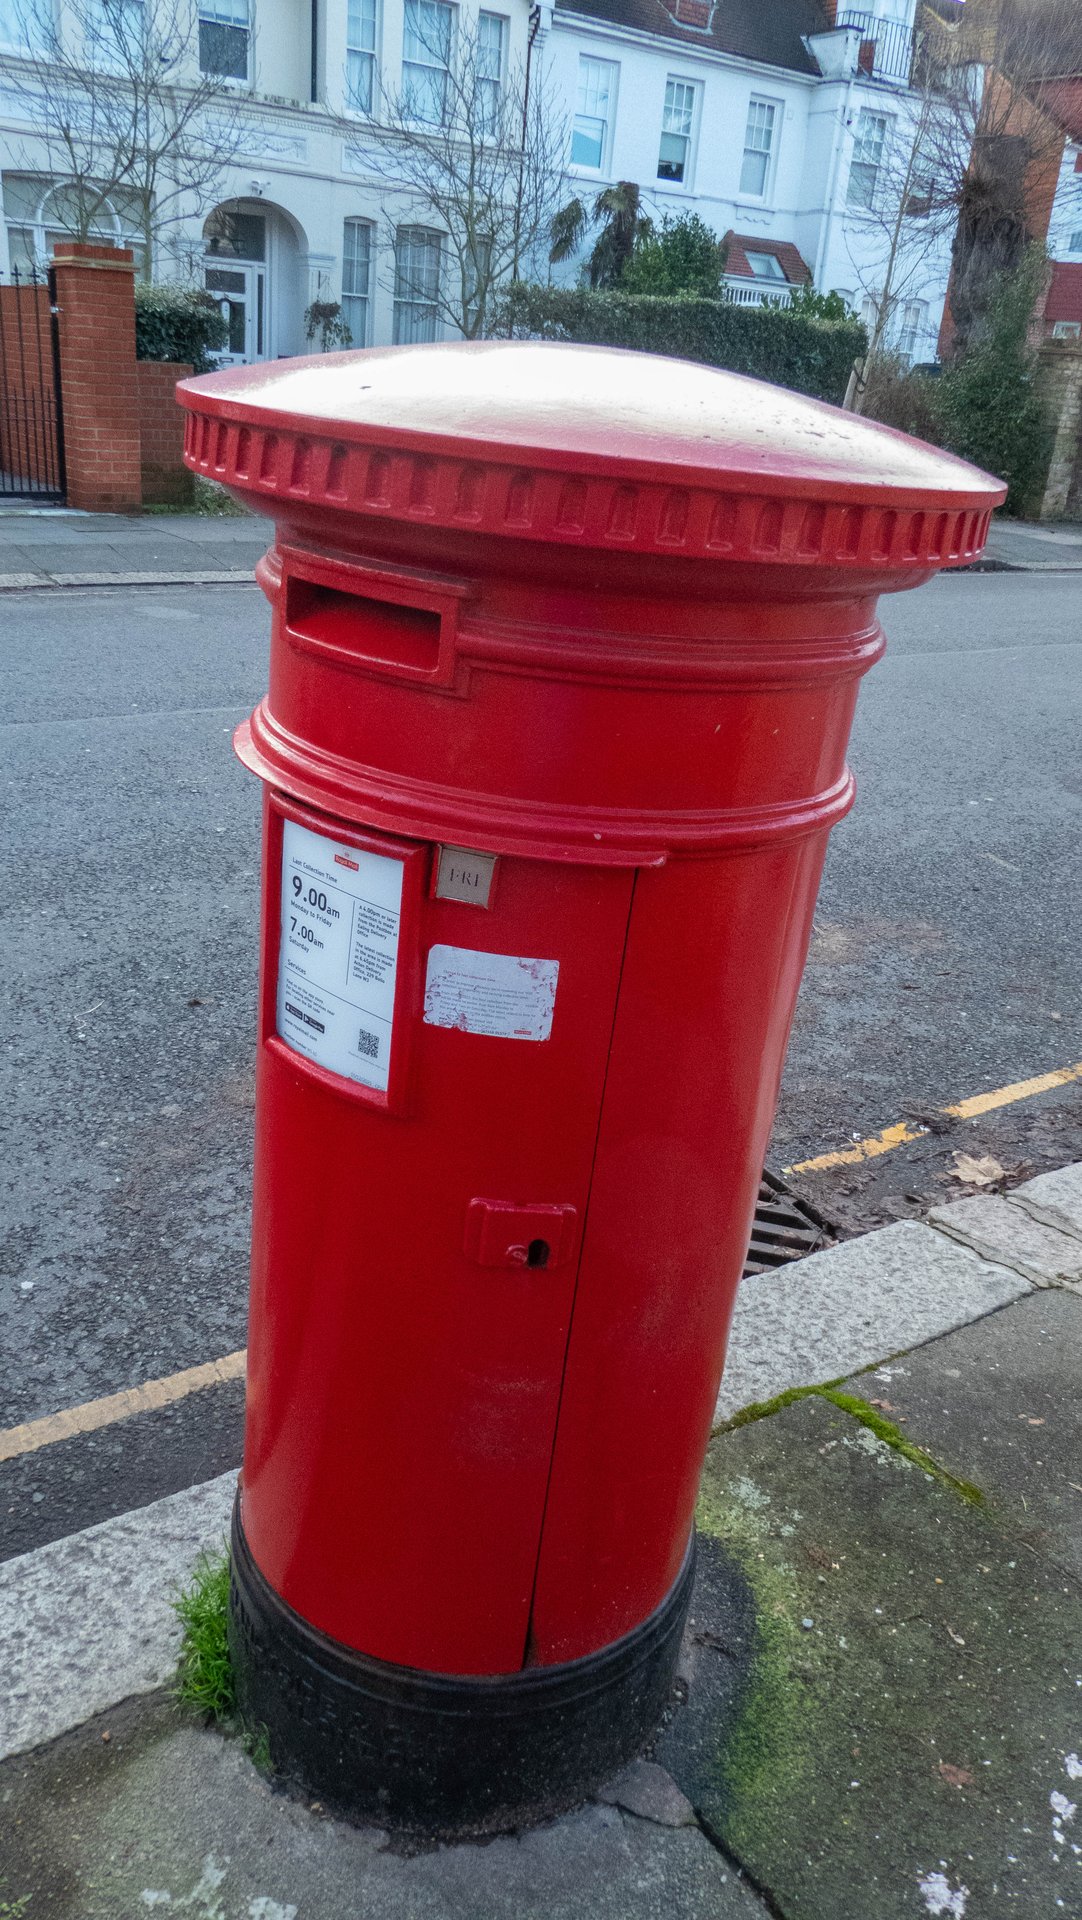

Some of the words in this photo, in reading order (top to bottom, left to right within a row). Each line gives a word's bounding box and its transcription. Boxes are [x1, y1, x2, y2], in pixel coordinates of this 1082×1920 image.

[293, 857, 302, 867] Last
[303, 862, 325, 878] Collection
[326, 873, 338, 884] Time
[450, 869, 479, 887] FRI
[292, 875, 340, 919] 9.00am
[291, 900, 309, 916] Monday
[310, 910, 316, 918] to
[317, 912, 333, 928] Friday
[289, 936, 310, 954] Saturday
[290, 916, 324, 950] 7.00am
[288, 959, 306, 975] Services
